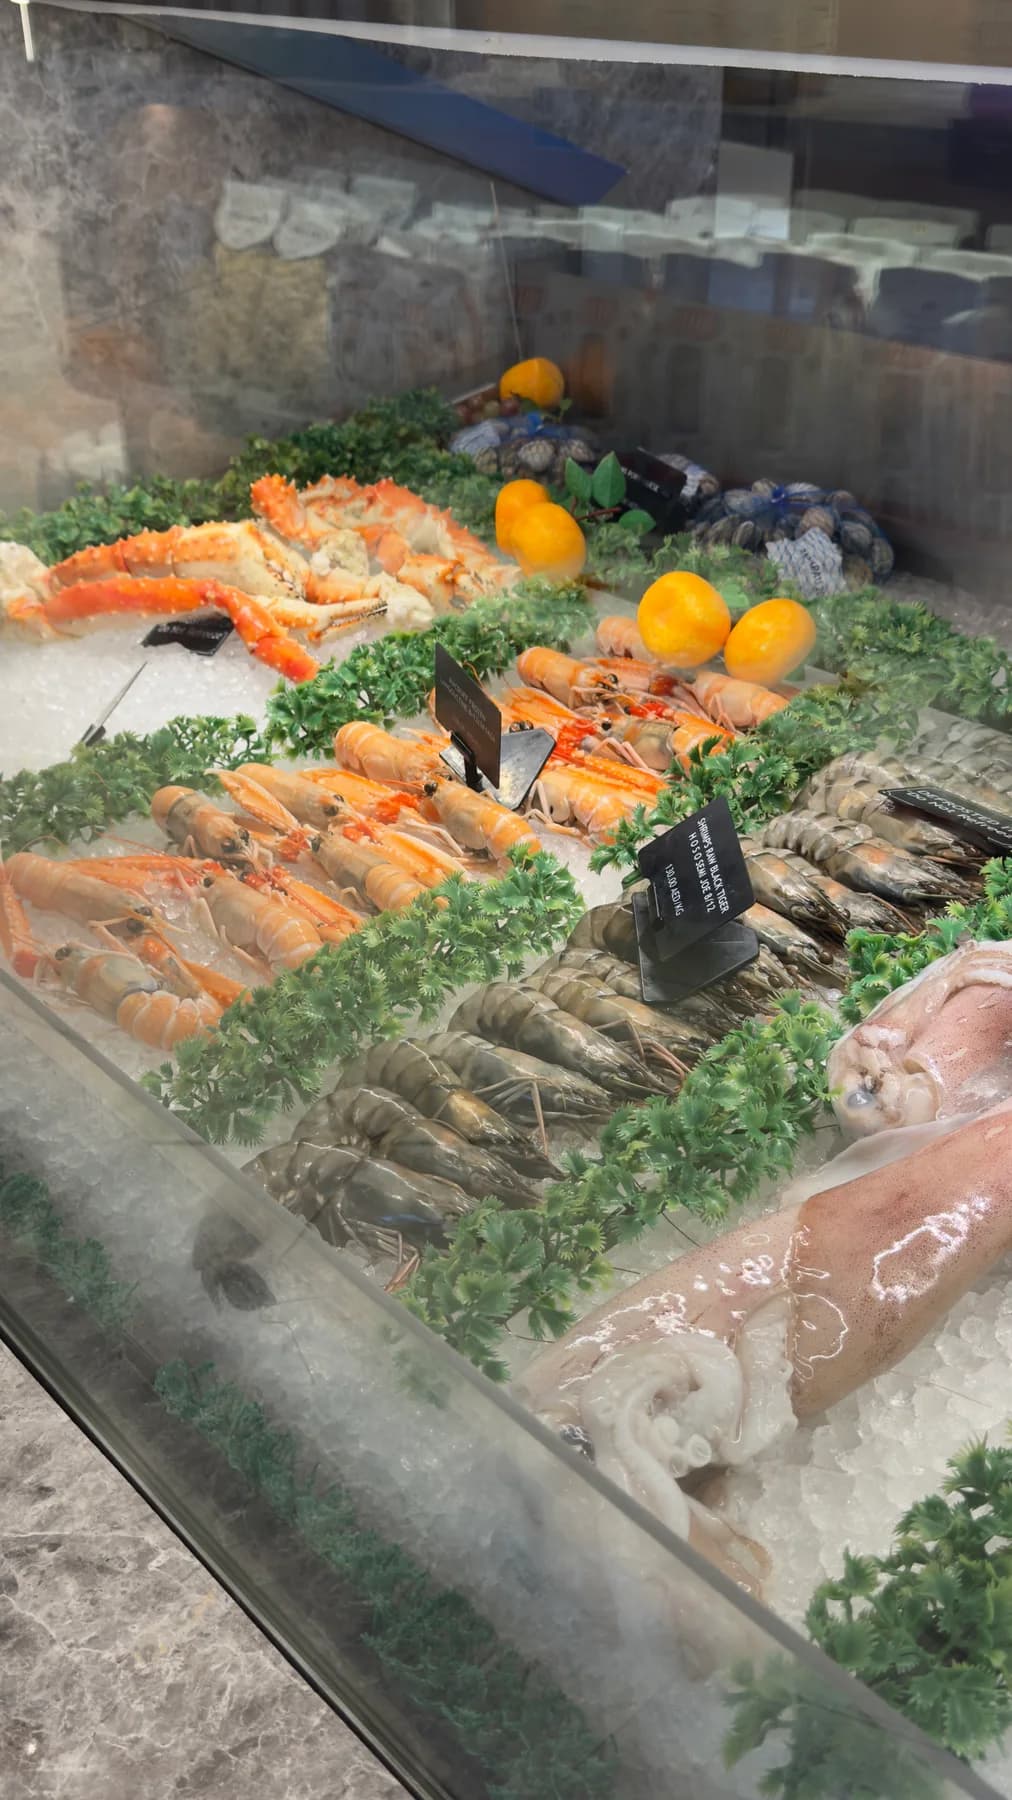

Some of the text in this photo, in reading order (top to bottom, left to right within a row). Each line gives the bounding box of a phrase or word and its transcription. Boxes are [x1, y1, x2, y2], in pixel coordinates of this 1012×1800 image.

[697, 817, 730, 914] SHRIMPS RAW BLACK TIGER
[700, 877, 711, 894] JOE
[671, 886, 685, 917] AED/KG
[704, 892, 716, 913] 8/12
